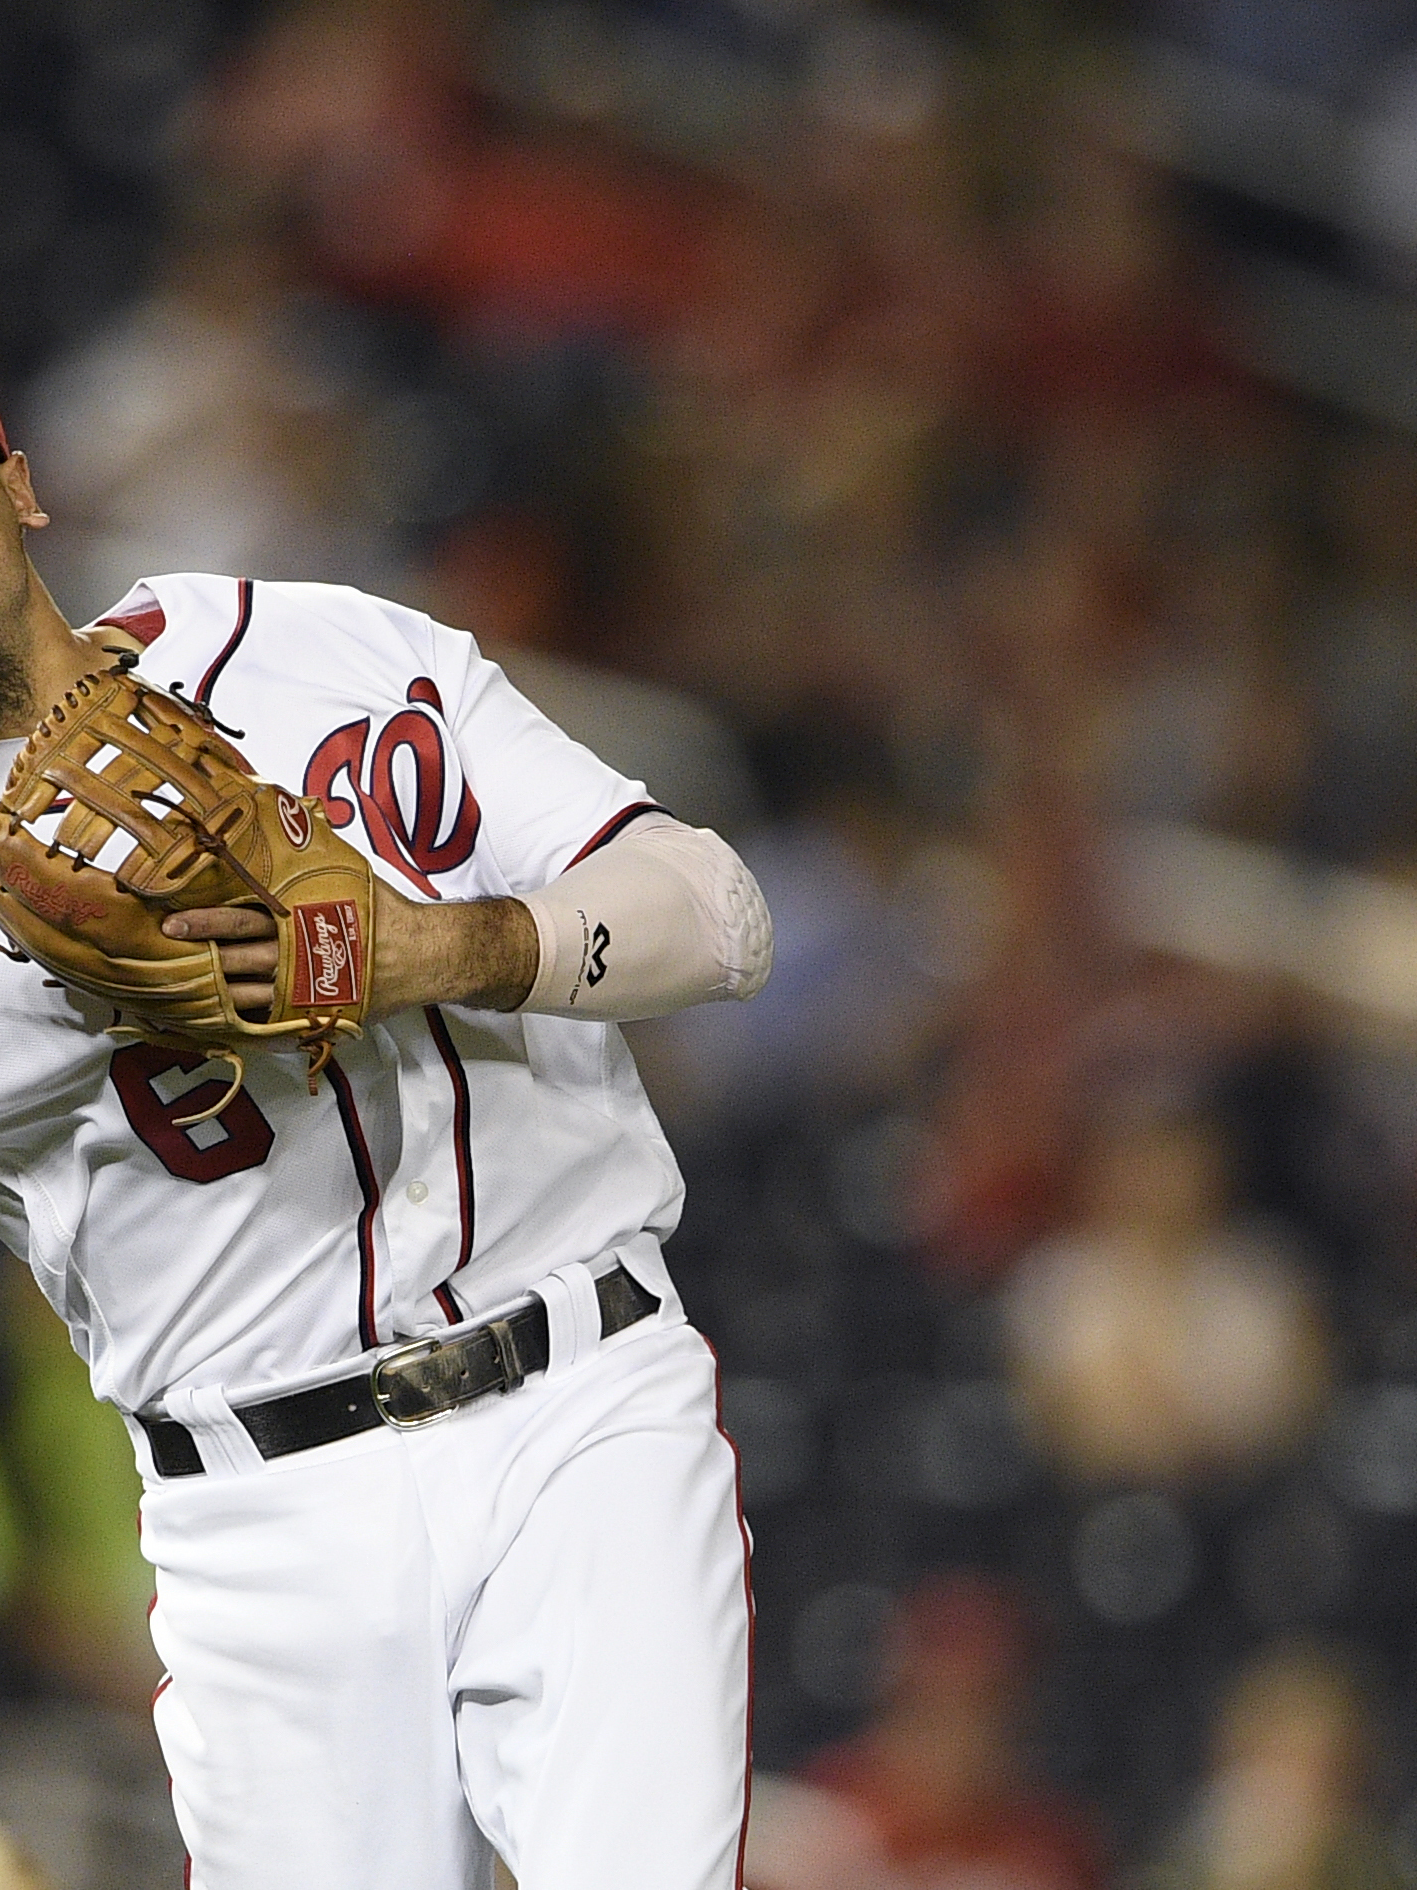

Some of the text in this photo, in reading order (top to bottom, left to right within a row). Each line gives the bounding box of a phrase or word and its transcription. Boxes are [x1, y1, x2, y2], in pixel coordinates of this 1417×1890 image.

[302, 676, 481, 900] W
[312, 912, 340, 997] Rawlings
[109, 1041, 275, 1183] 6
